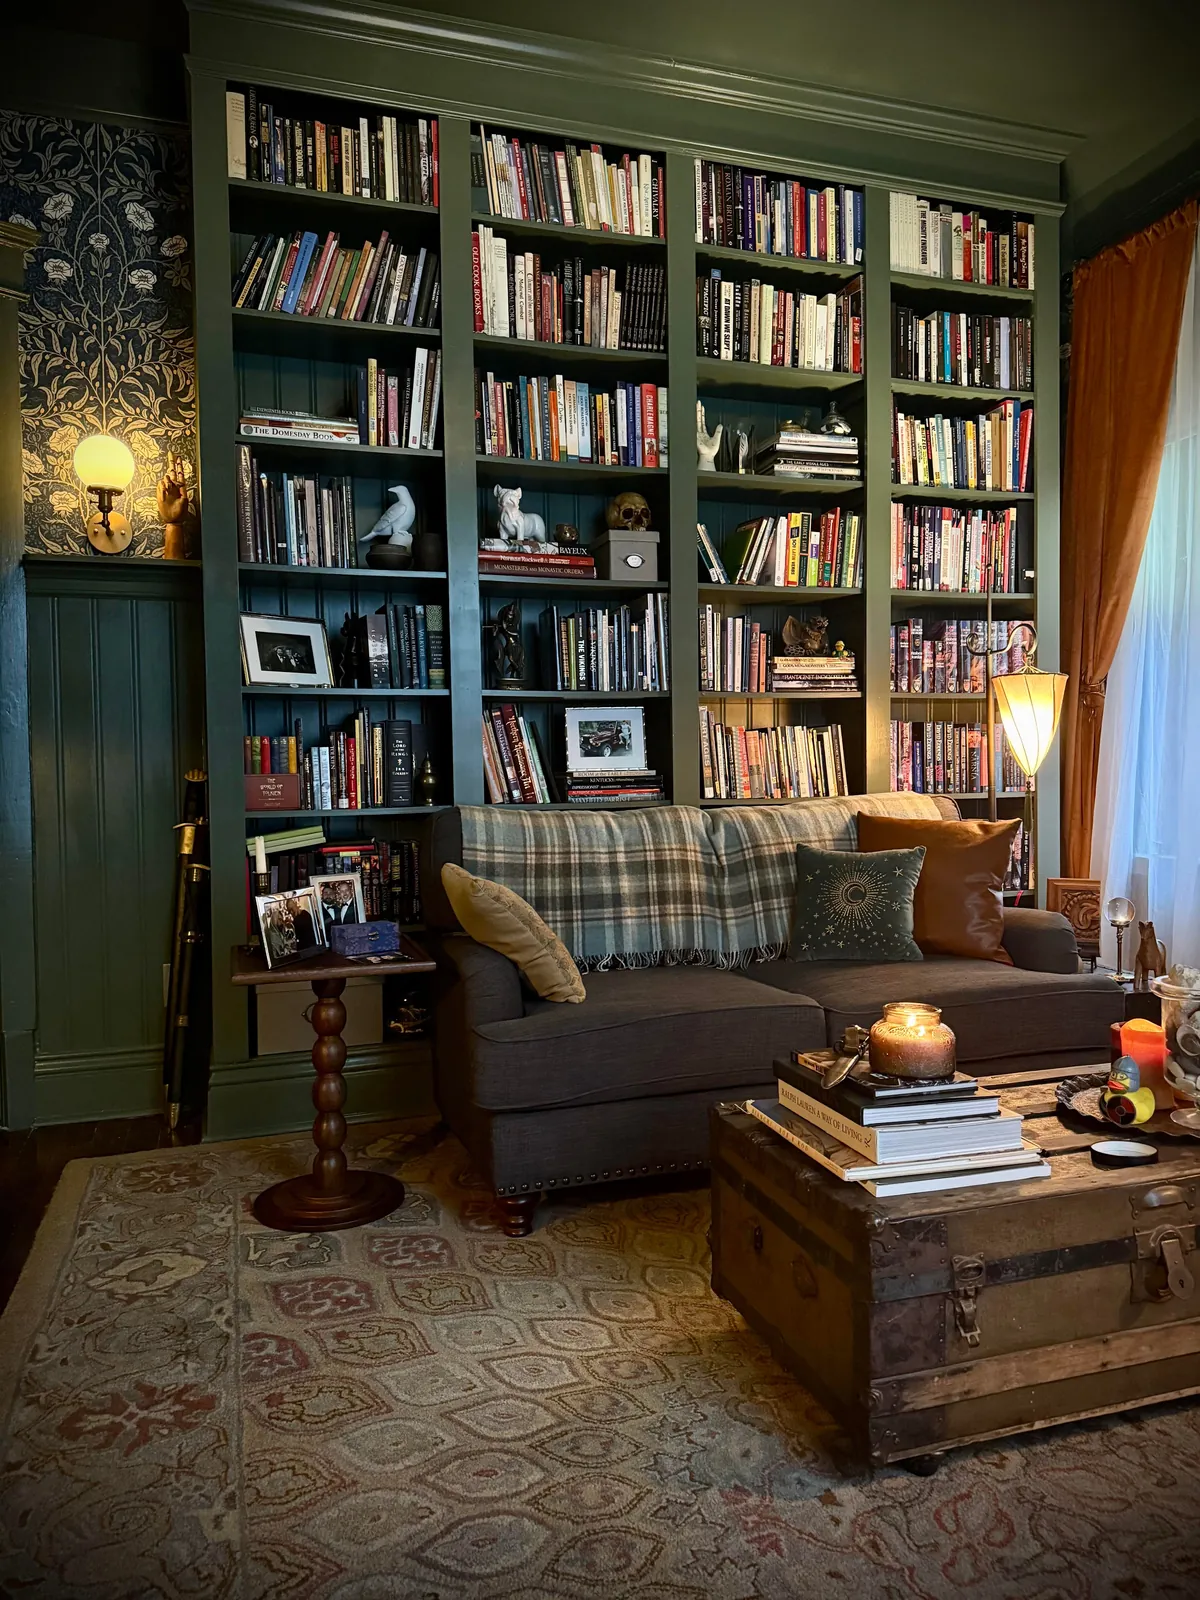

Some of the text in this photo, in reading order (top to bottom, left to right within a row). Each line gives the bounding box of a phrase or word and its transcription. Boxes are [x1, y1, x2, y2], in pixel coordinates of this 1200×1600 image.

[249, 112, 257, 134] QUEEN
[396, 256, 406, 274] GOOD
[724, 324, 730, 333] WE
[646, 395, 654, 436] CHARLEMAGNE
[272, 428, 311, 438] DOMESDAY
[313, 430, 334, 440] BOOK
[244, 501, 252, 546] CHRONICLE
[559, 546, 587, 555] BAYEUX
[496, 720, 509, 762] RENAISSANCE
[506, 715, 520, 743] Northern
[513, 742, 528, 776] Renaissance
[781, 1088, 797, 1105] RALPH
[796, 1098, 816, 1116] LAUREN
[821, 1112, 834, 1126] WAY
[833, 1120, 840, 1130] OF
[841, 1124, 862, 1142] LIVING
